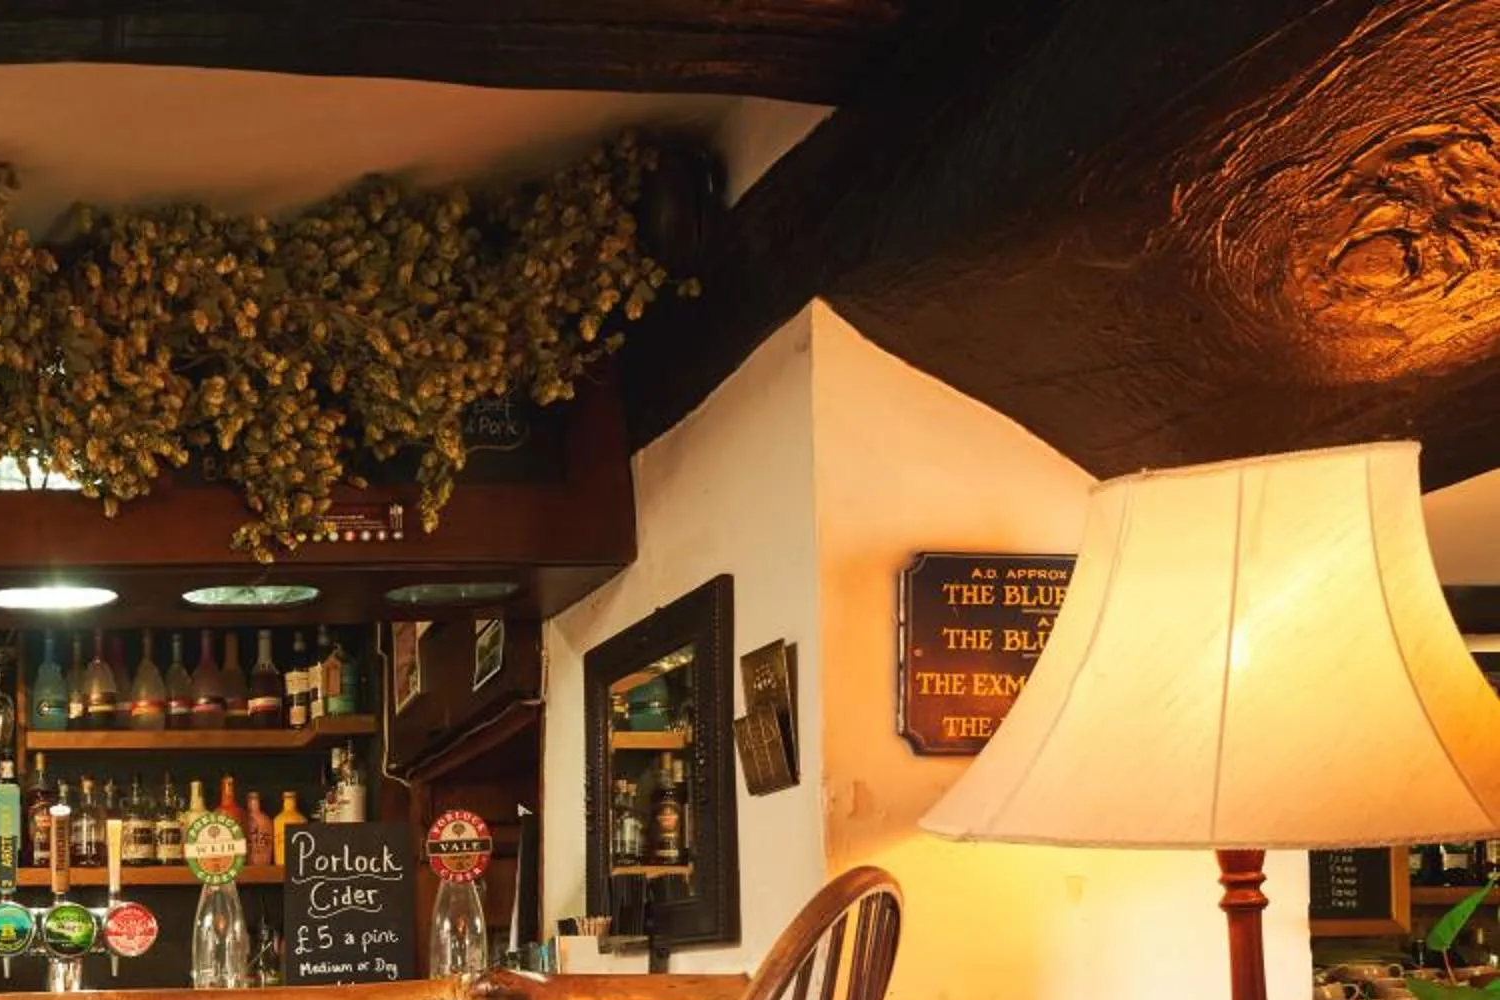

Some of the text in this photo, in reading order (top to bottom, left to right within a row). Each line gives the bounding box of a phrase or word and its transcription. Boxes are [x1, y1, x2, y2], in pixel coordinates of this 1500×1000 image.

[942, 583, 995, 606] THE
[942, 628, 1049, 652] THE BLU
[915, 671, 1028, 697] THE EXM
[942, 715, 993, 738] THE
[291, 831, 402, 877] Porlock
[439, 841, 481, 852] VALE
[310, 882, 379, 911] Cider
[343, 935, 355, 946] a
[361, 930, 399, 953] pint
[300, 959, 353, 976] Medium
[357, 962, 370, 973] or
